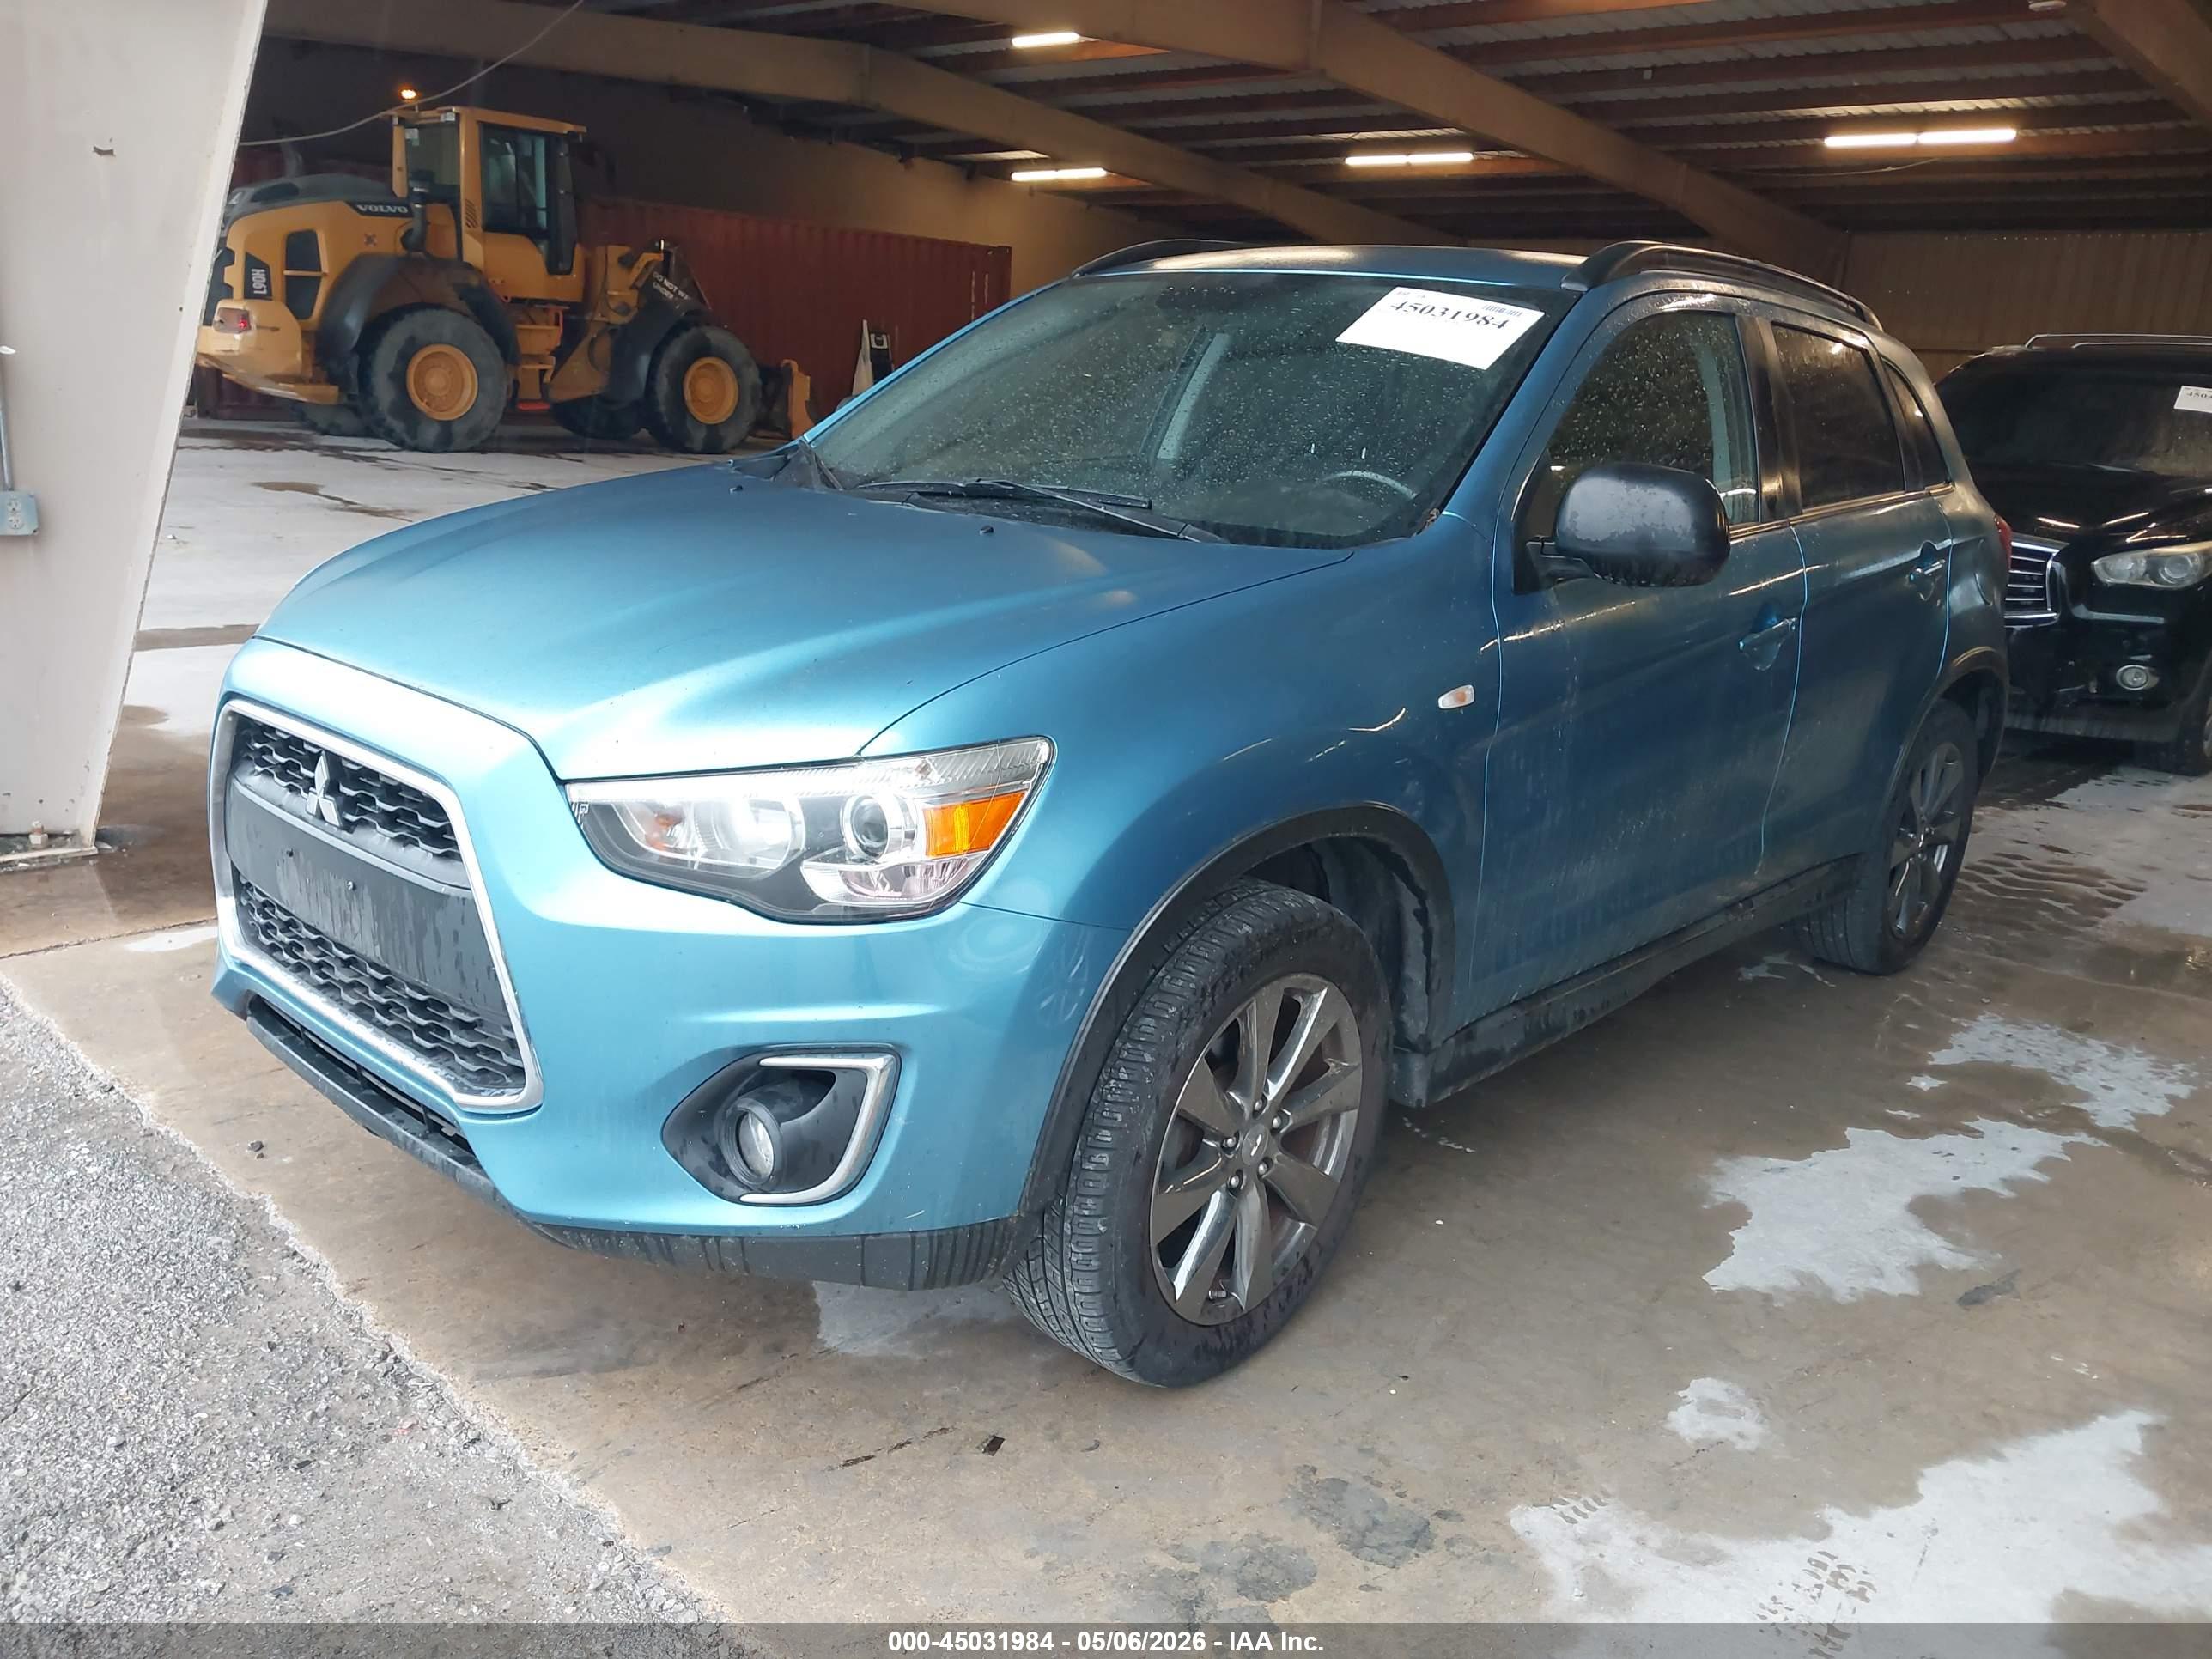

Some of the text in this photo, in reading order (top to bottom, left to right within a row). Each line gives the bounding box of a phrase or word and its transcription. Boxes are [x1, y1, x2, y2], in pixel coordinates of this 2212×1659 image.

[357, 204, 409, 214] VOLVO
[251, 268, 268, 295] L90H
[664, 277, 678, 293] NOT
[1390, 301, 1510, 329] 45031984
